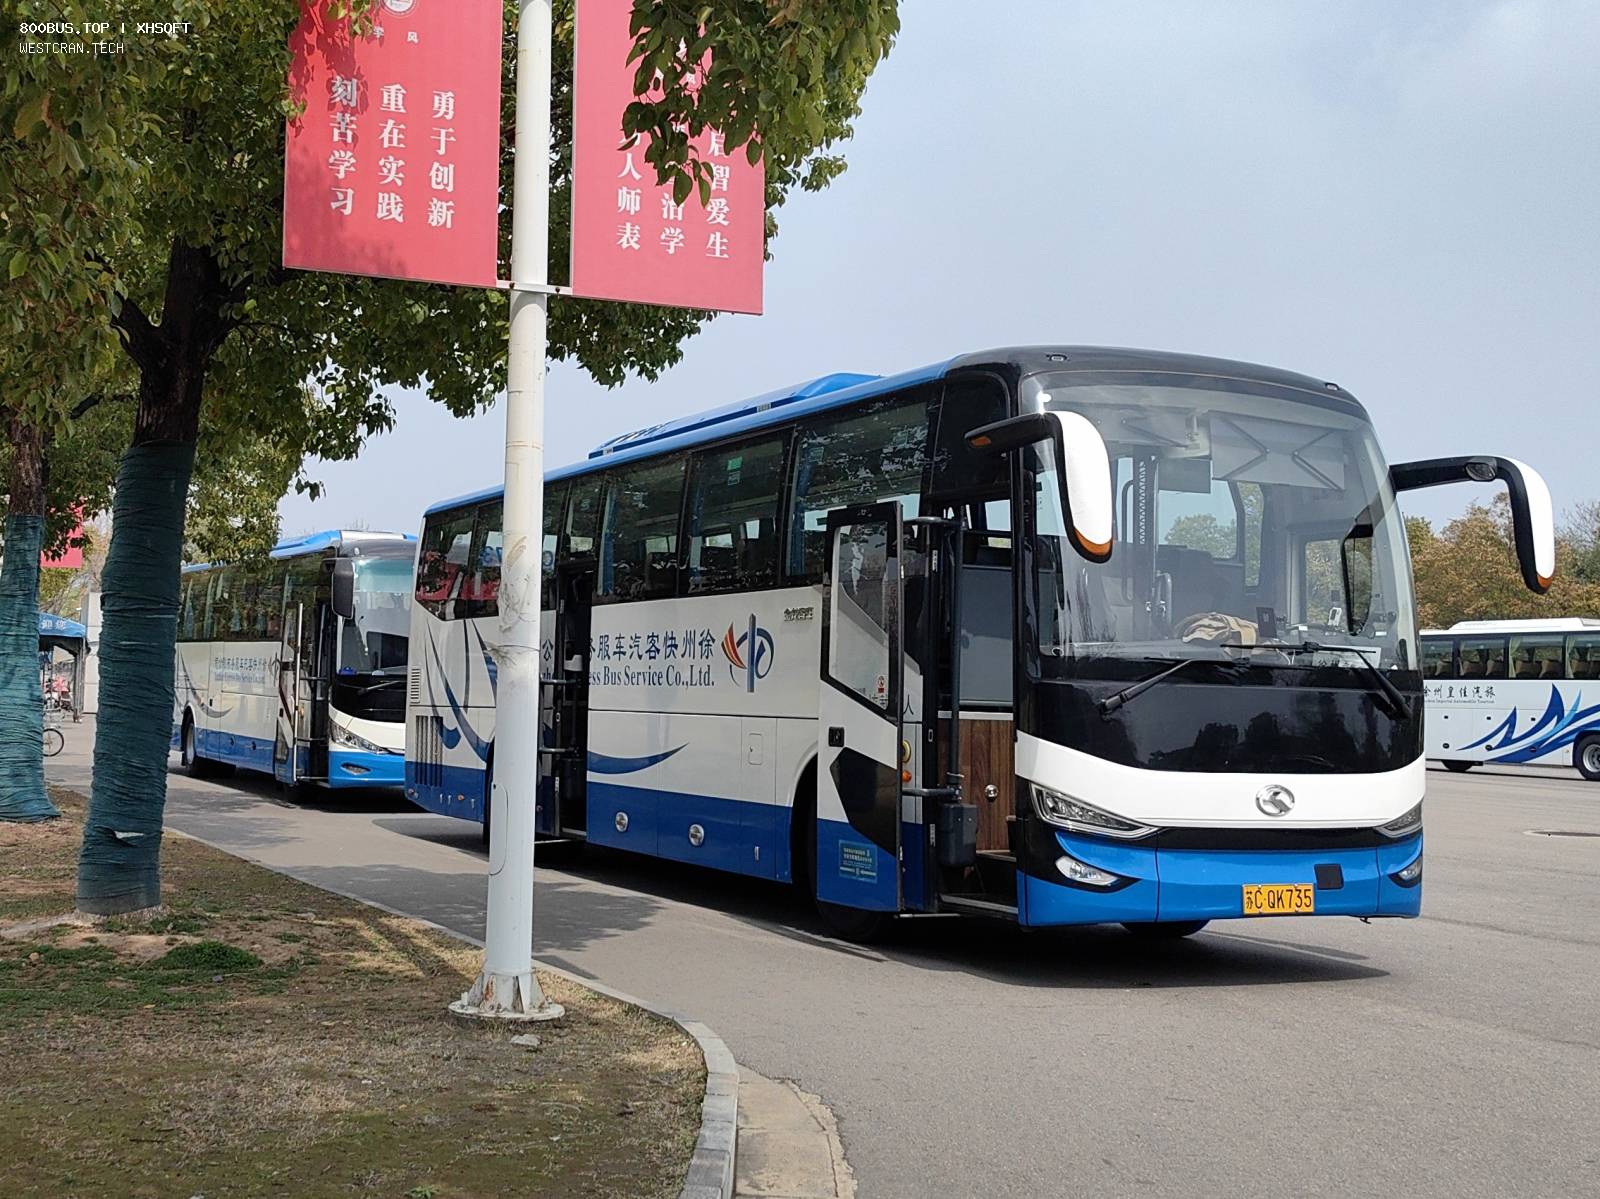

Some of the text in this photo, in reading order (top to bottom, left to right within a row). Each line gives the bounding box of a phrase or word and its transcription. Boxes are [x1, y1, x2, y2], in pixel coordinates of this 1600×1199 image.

[328, 75, 358, 216] 刻苦学习
[376, 83, 407, 223] 重在实践
[427, 90, 456, 229] 勇于创新
[603, 666, 622, 686] Bus
[624, 664, 663, 686] Service
